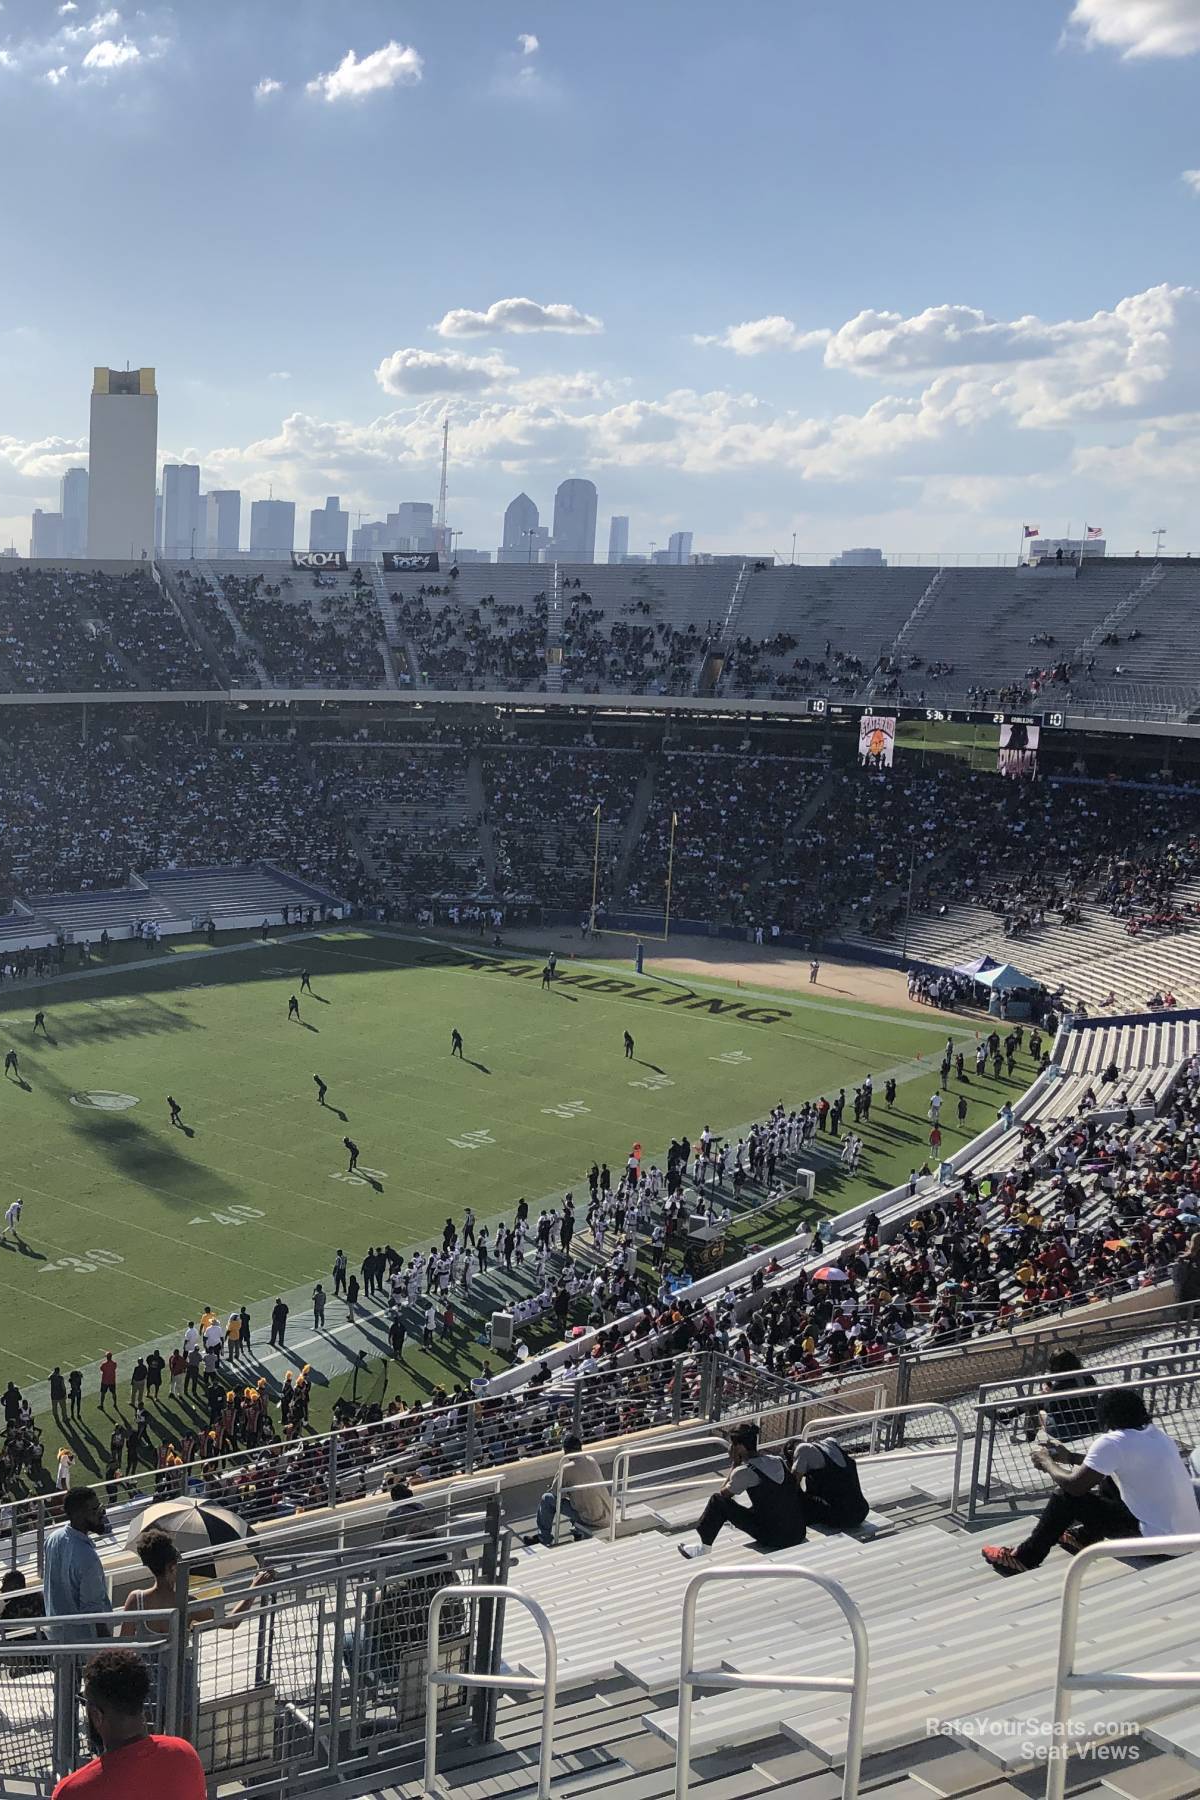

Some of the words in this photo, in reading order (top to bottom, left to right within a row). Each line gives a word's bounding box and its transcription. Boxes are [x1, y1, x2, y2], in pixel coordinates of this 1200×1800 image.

[812, 700, 825, 712] 10
[993, 714, 1005, 723] 23
[1049, 713, 1062, 726] 10
[415, 950, 793, 1024] GRAMBLING
[447, 1129, 497, 1150] 40
[209, 1204, 267, 1227] 40
[54, 1248, 126, 1274] 30
